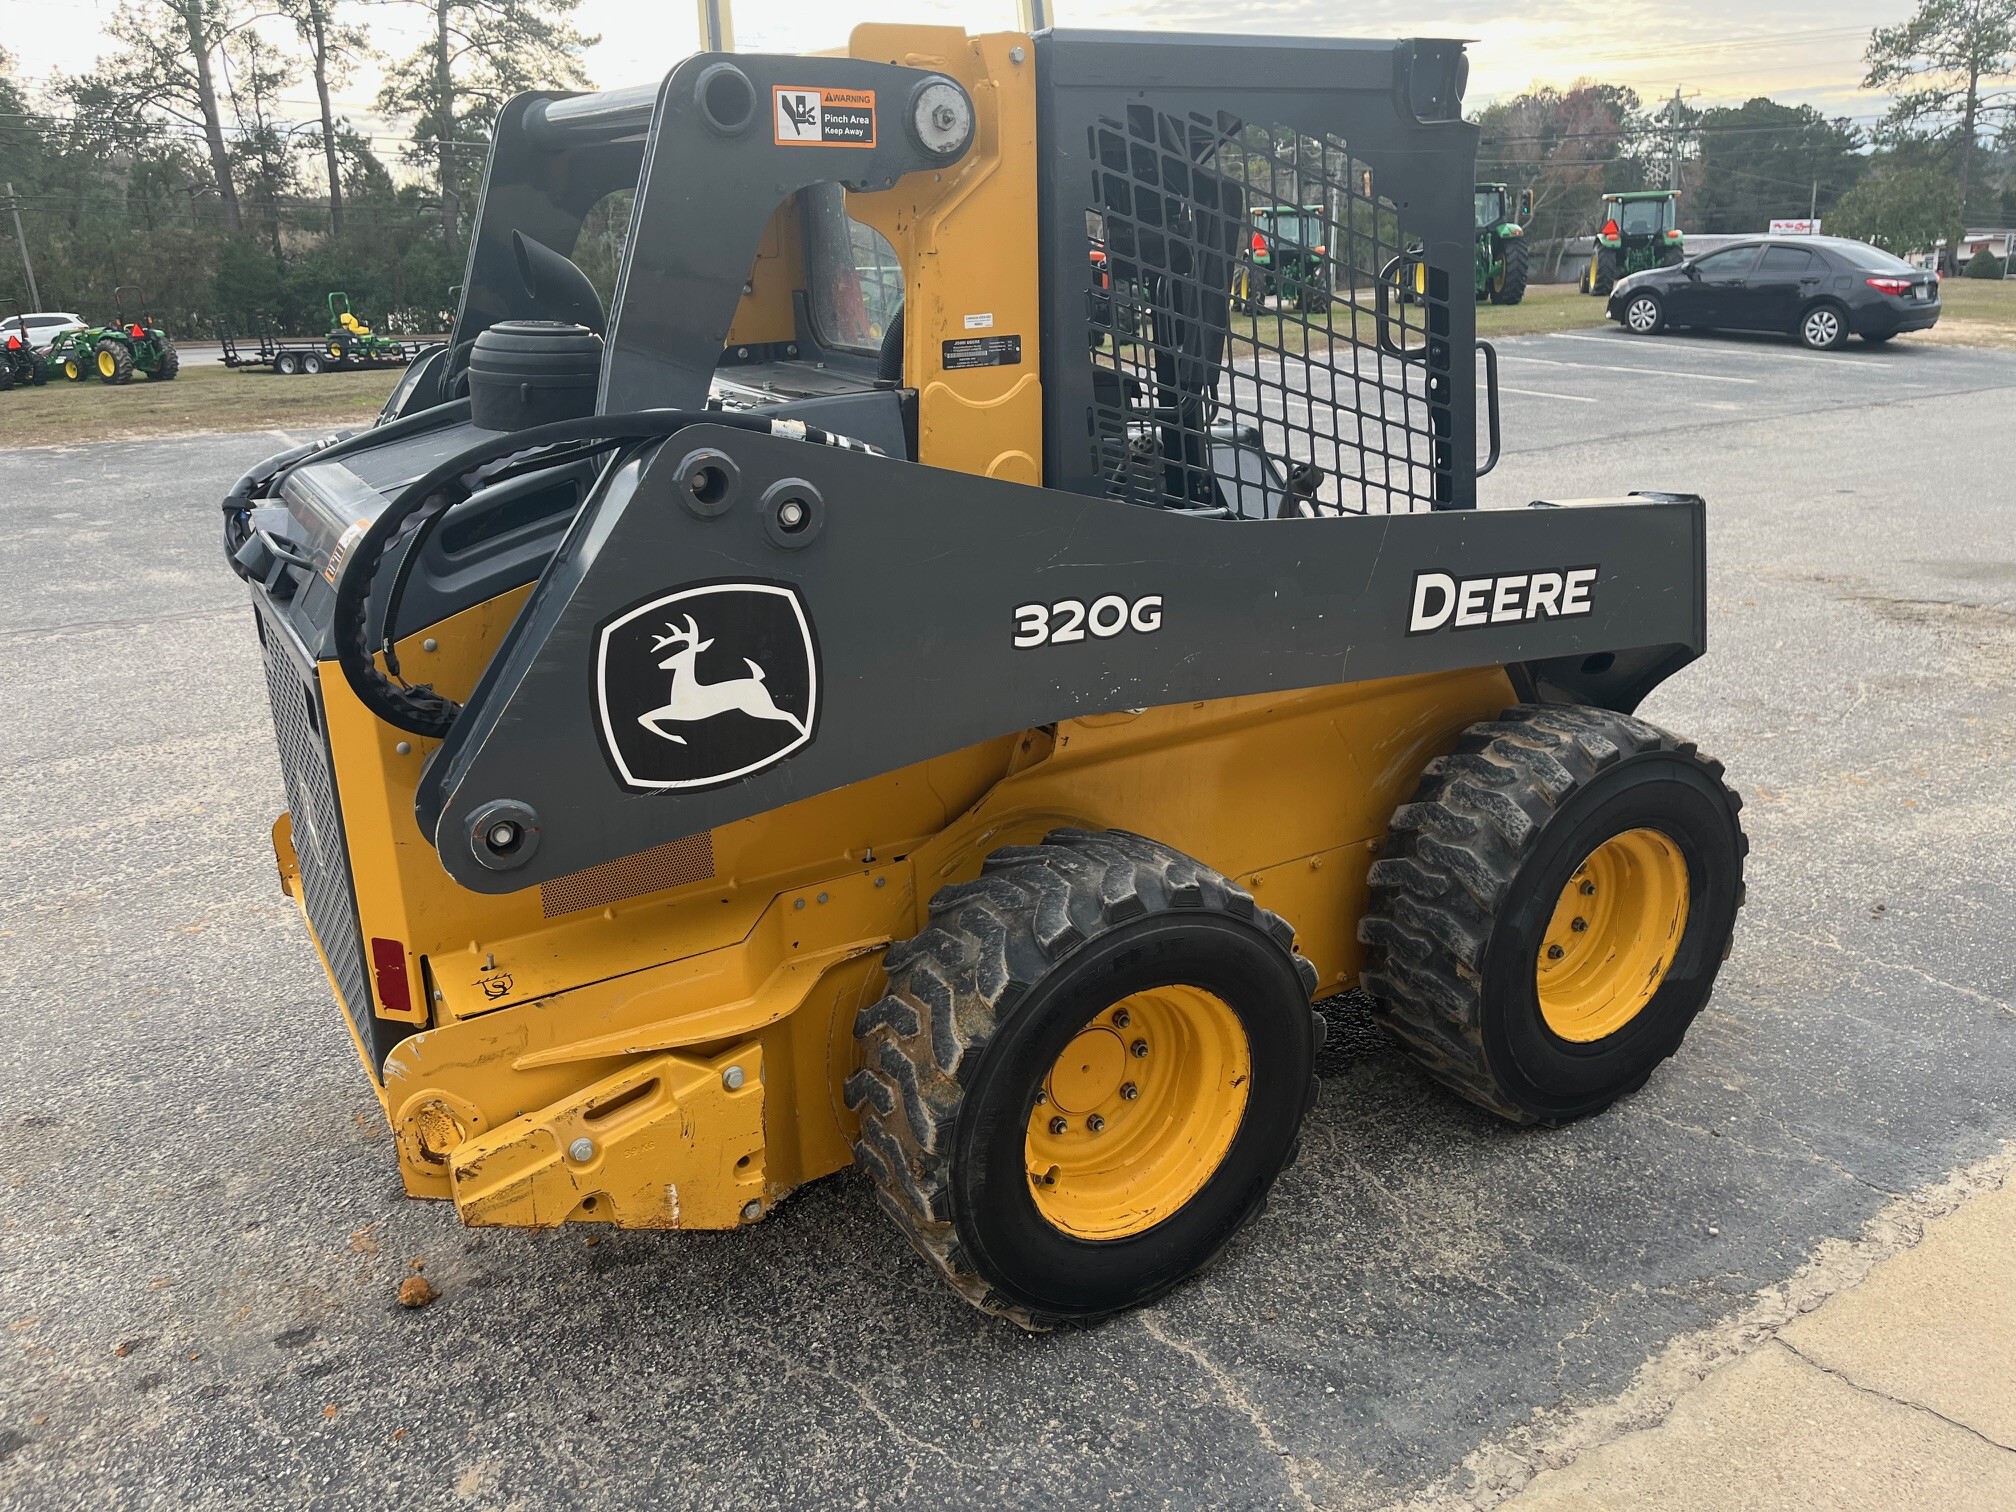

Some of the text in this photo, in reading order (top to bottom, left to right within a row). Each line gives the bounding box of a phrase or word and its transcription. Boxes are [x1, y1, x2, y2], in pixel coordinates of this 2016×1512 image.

[833, 94, 871, 103] WARNING
[824, 114, 869, 124] Pinch Area
[824, 126, 864, 137] Keep Away
[1410, 568, 1597, 632] DEERE
[1014, 595, 1163, 647] 320G
